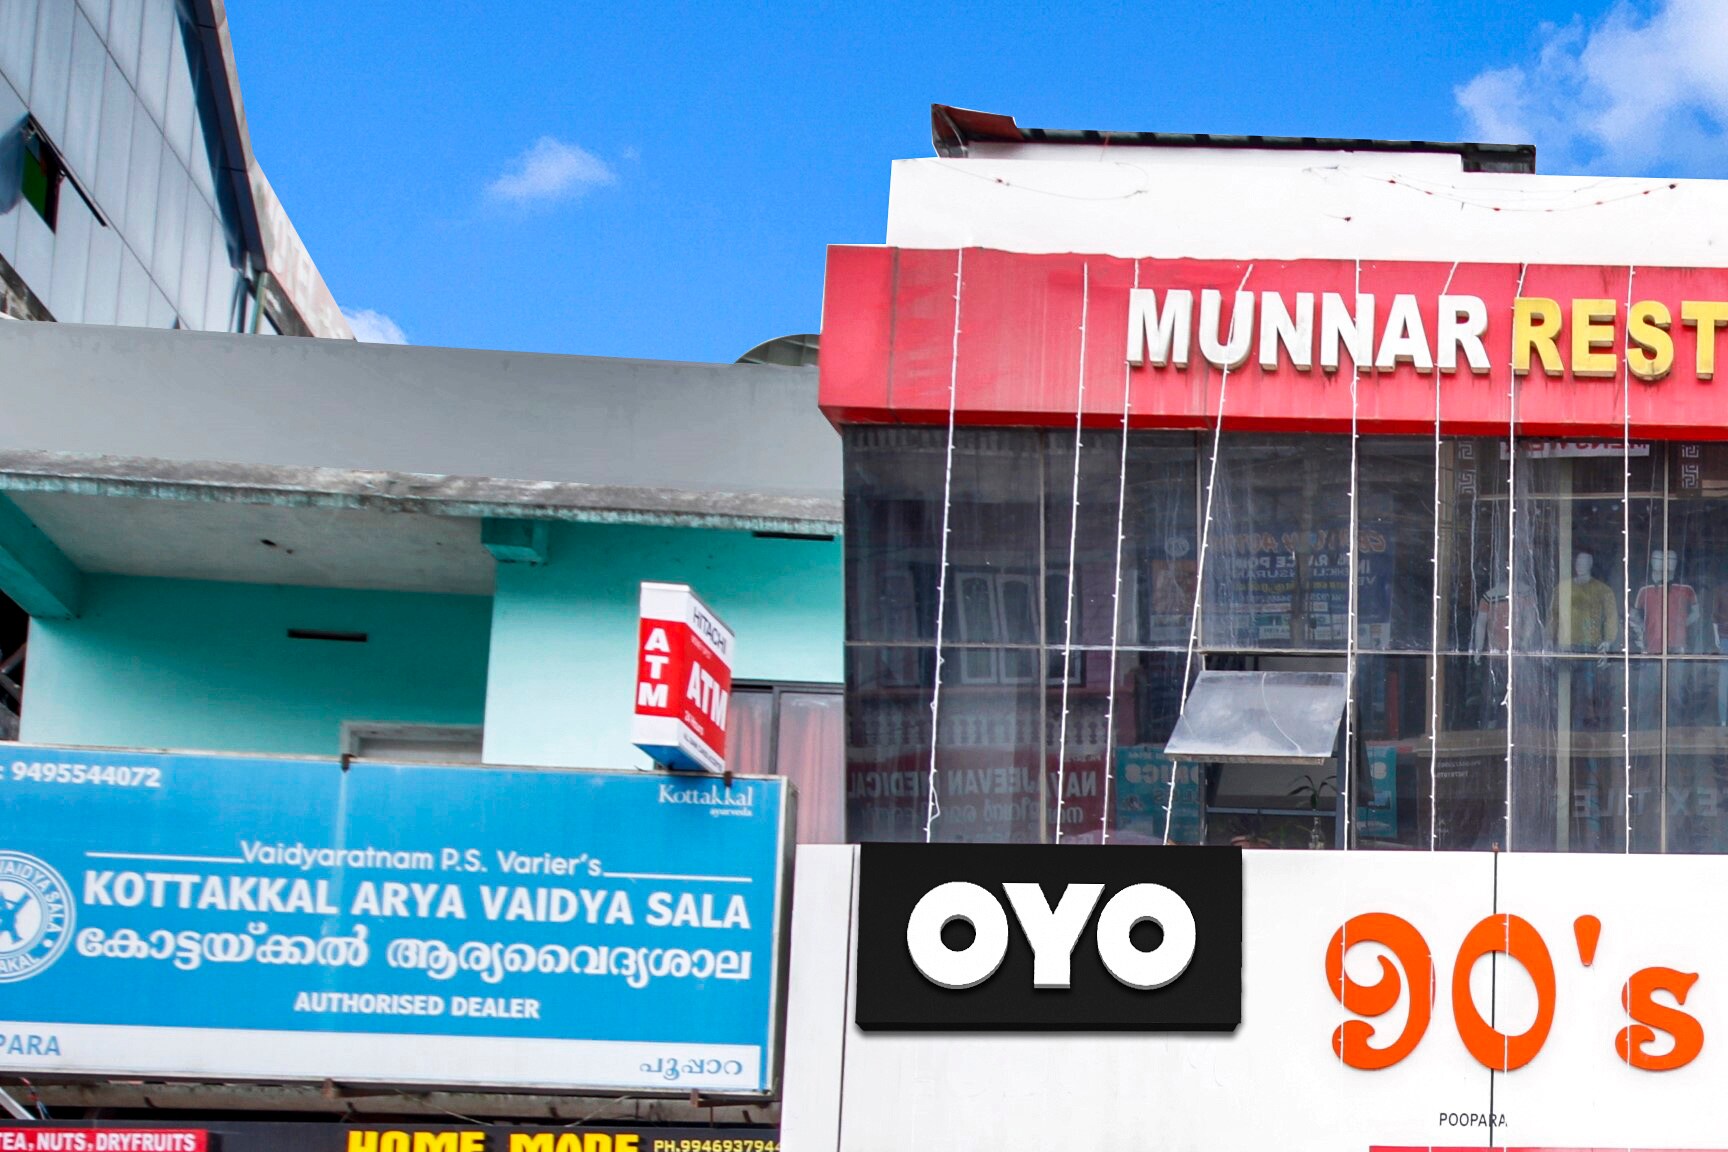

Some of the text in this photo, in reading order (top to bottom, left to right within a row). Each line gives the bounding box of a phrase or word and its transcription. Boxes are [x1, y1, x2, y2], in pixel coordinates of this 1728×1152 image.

[1127, 287, 1492, 377] MUNNAR
[692, 605, 727, 655] HITACHI
[637, 627, 671, 708] ATM
[686, 660, 728, 731] ATM
[12, 761, 161, 788] 9495544072
[658, 783, 754, 807] Kottakkal
[709, 807, 753, 817] ayurveda
[240, 840, 603, 877] Vaidyaratnam P.S. Varier's
[83, 869, 753, 930] KOTTAKKAL ARYA VAIDYA SALA
[906, 880, 1198, 991] OYO
[293, 990, 541, 1020] AUTHORISED DEALER
[1324, 911, 1705, 1071] 90's
[1439, 1112, 1507, 1128] POOPARA
[96, 1132, 197, 1152] DRYFRUITS
